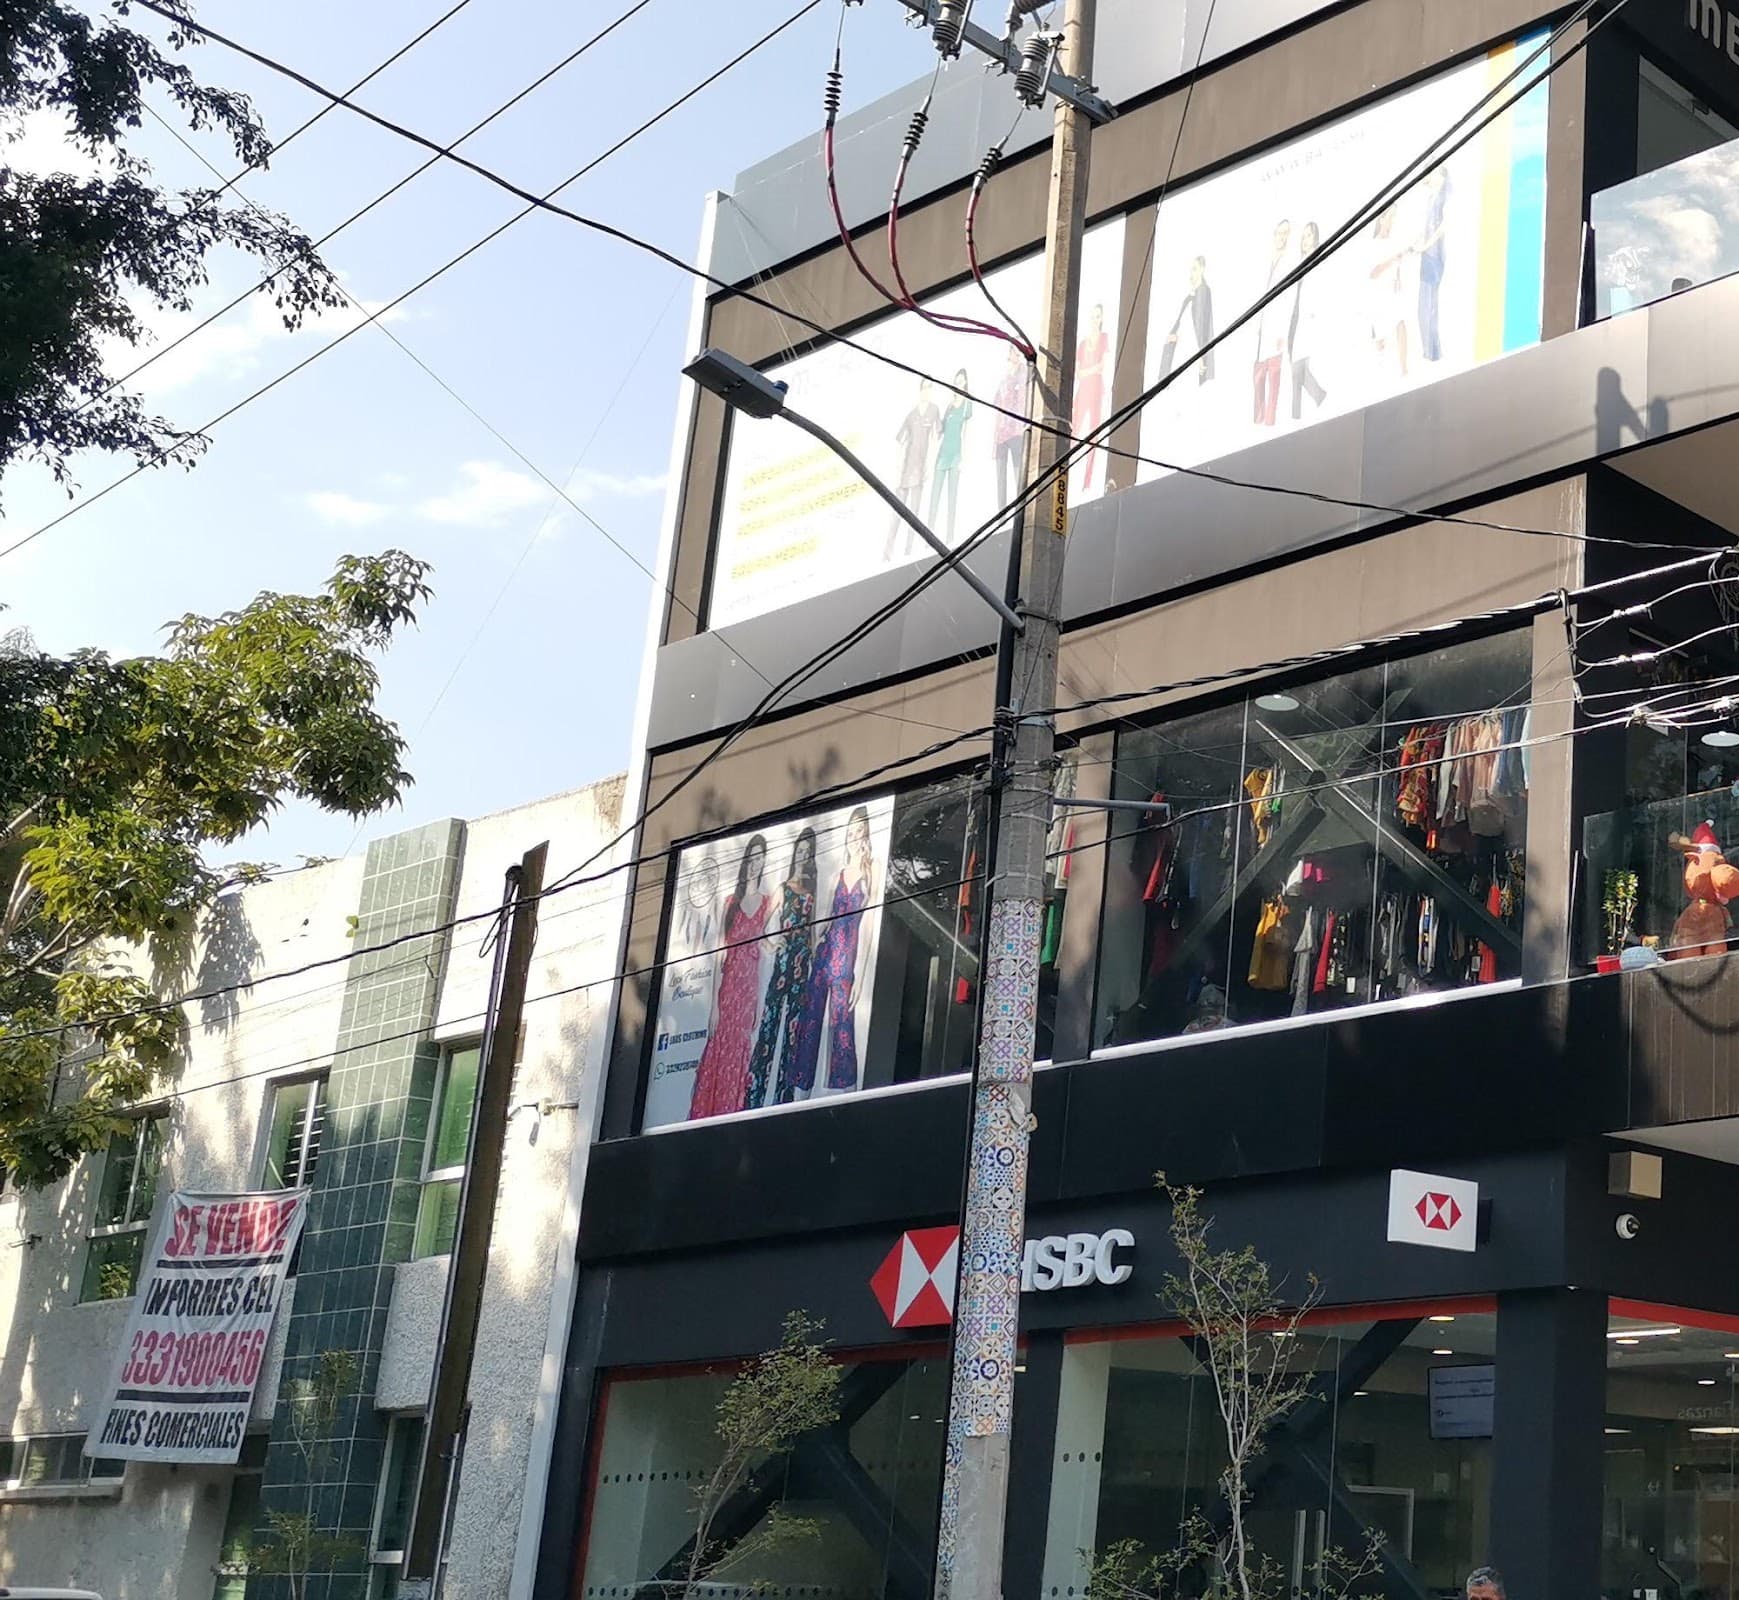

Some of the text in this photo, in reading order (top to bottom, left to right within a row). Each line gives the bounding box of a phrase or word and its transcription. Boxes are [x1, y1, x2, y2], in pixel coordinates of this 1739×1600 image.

[165, 1204, 205, 1258] SE
[142, 1273, 278, 1318] INFORMES CEL
[121, 1328, 266, 1388] 3331900456
[100, 1408, 246, 1450] FINES COMERCIALES
